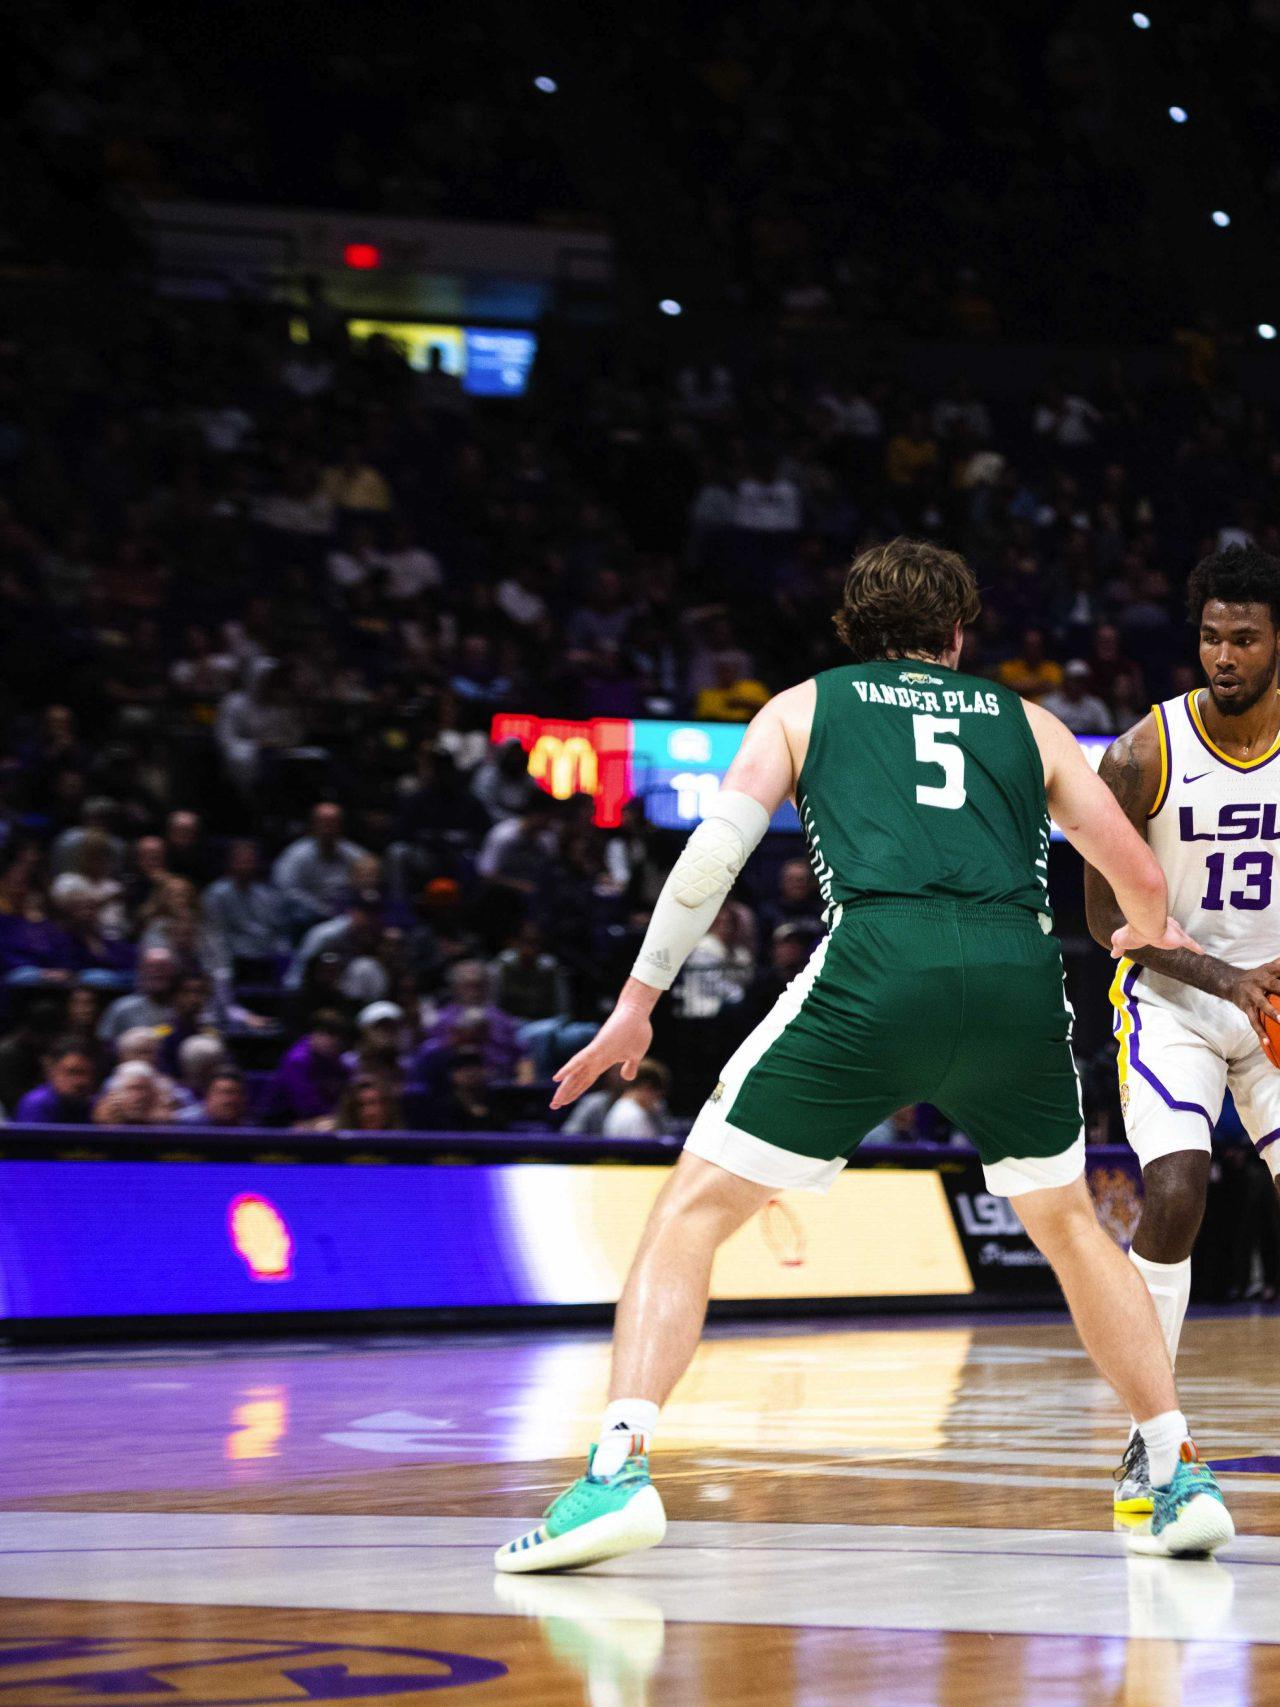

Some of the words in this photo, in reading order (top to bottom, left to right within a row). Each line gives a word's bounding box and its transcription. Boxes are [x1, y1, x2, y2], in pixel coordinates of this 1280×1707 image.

[852, 681, 941, 712] VANDER
[942, 690, 1000, 716] PLAS
[913, 714, 967, 810] 5
[1201, 851, 1273, 911] 13
